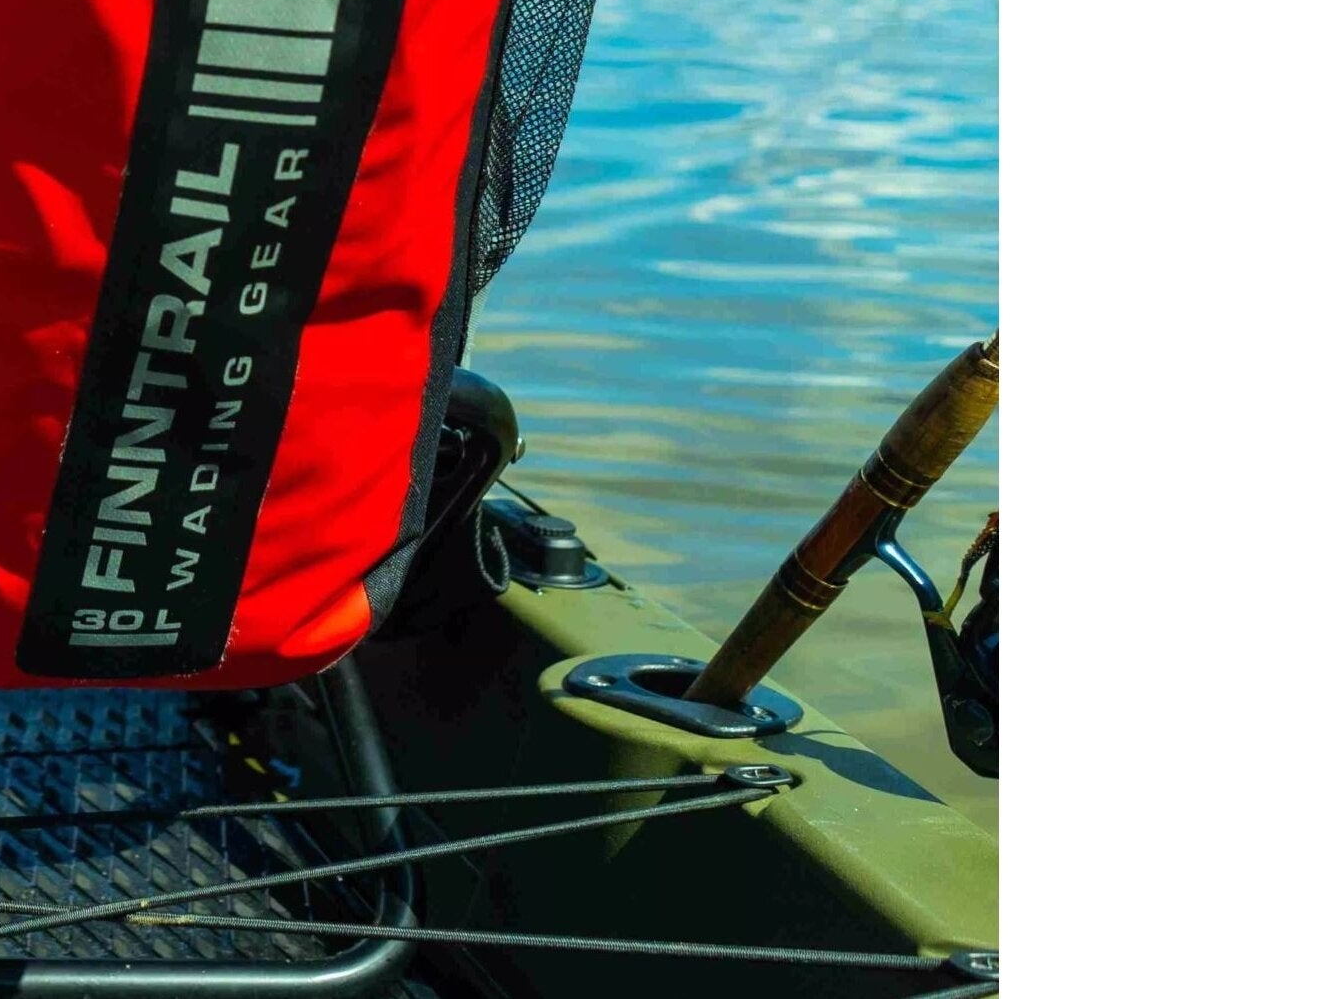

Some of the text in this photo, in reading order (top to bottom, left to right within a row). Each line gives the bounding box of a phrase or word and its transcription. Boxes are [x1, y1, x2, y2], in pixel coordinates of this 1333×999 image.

[82, 143, 240, 593] FINNTRAIL
[167, 148, 310, 591] WADING GEAR
